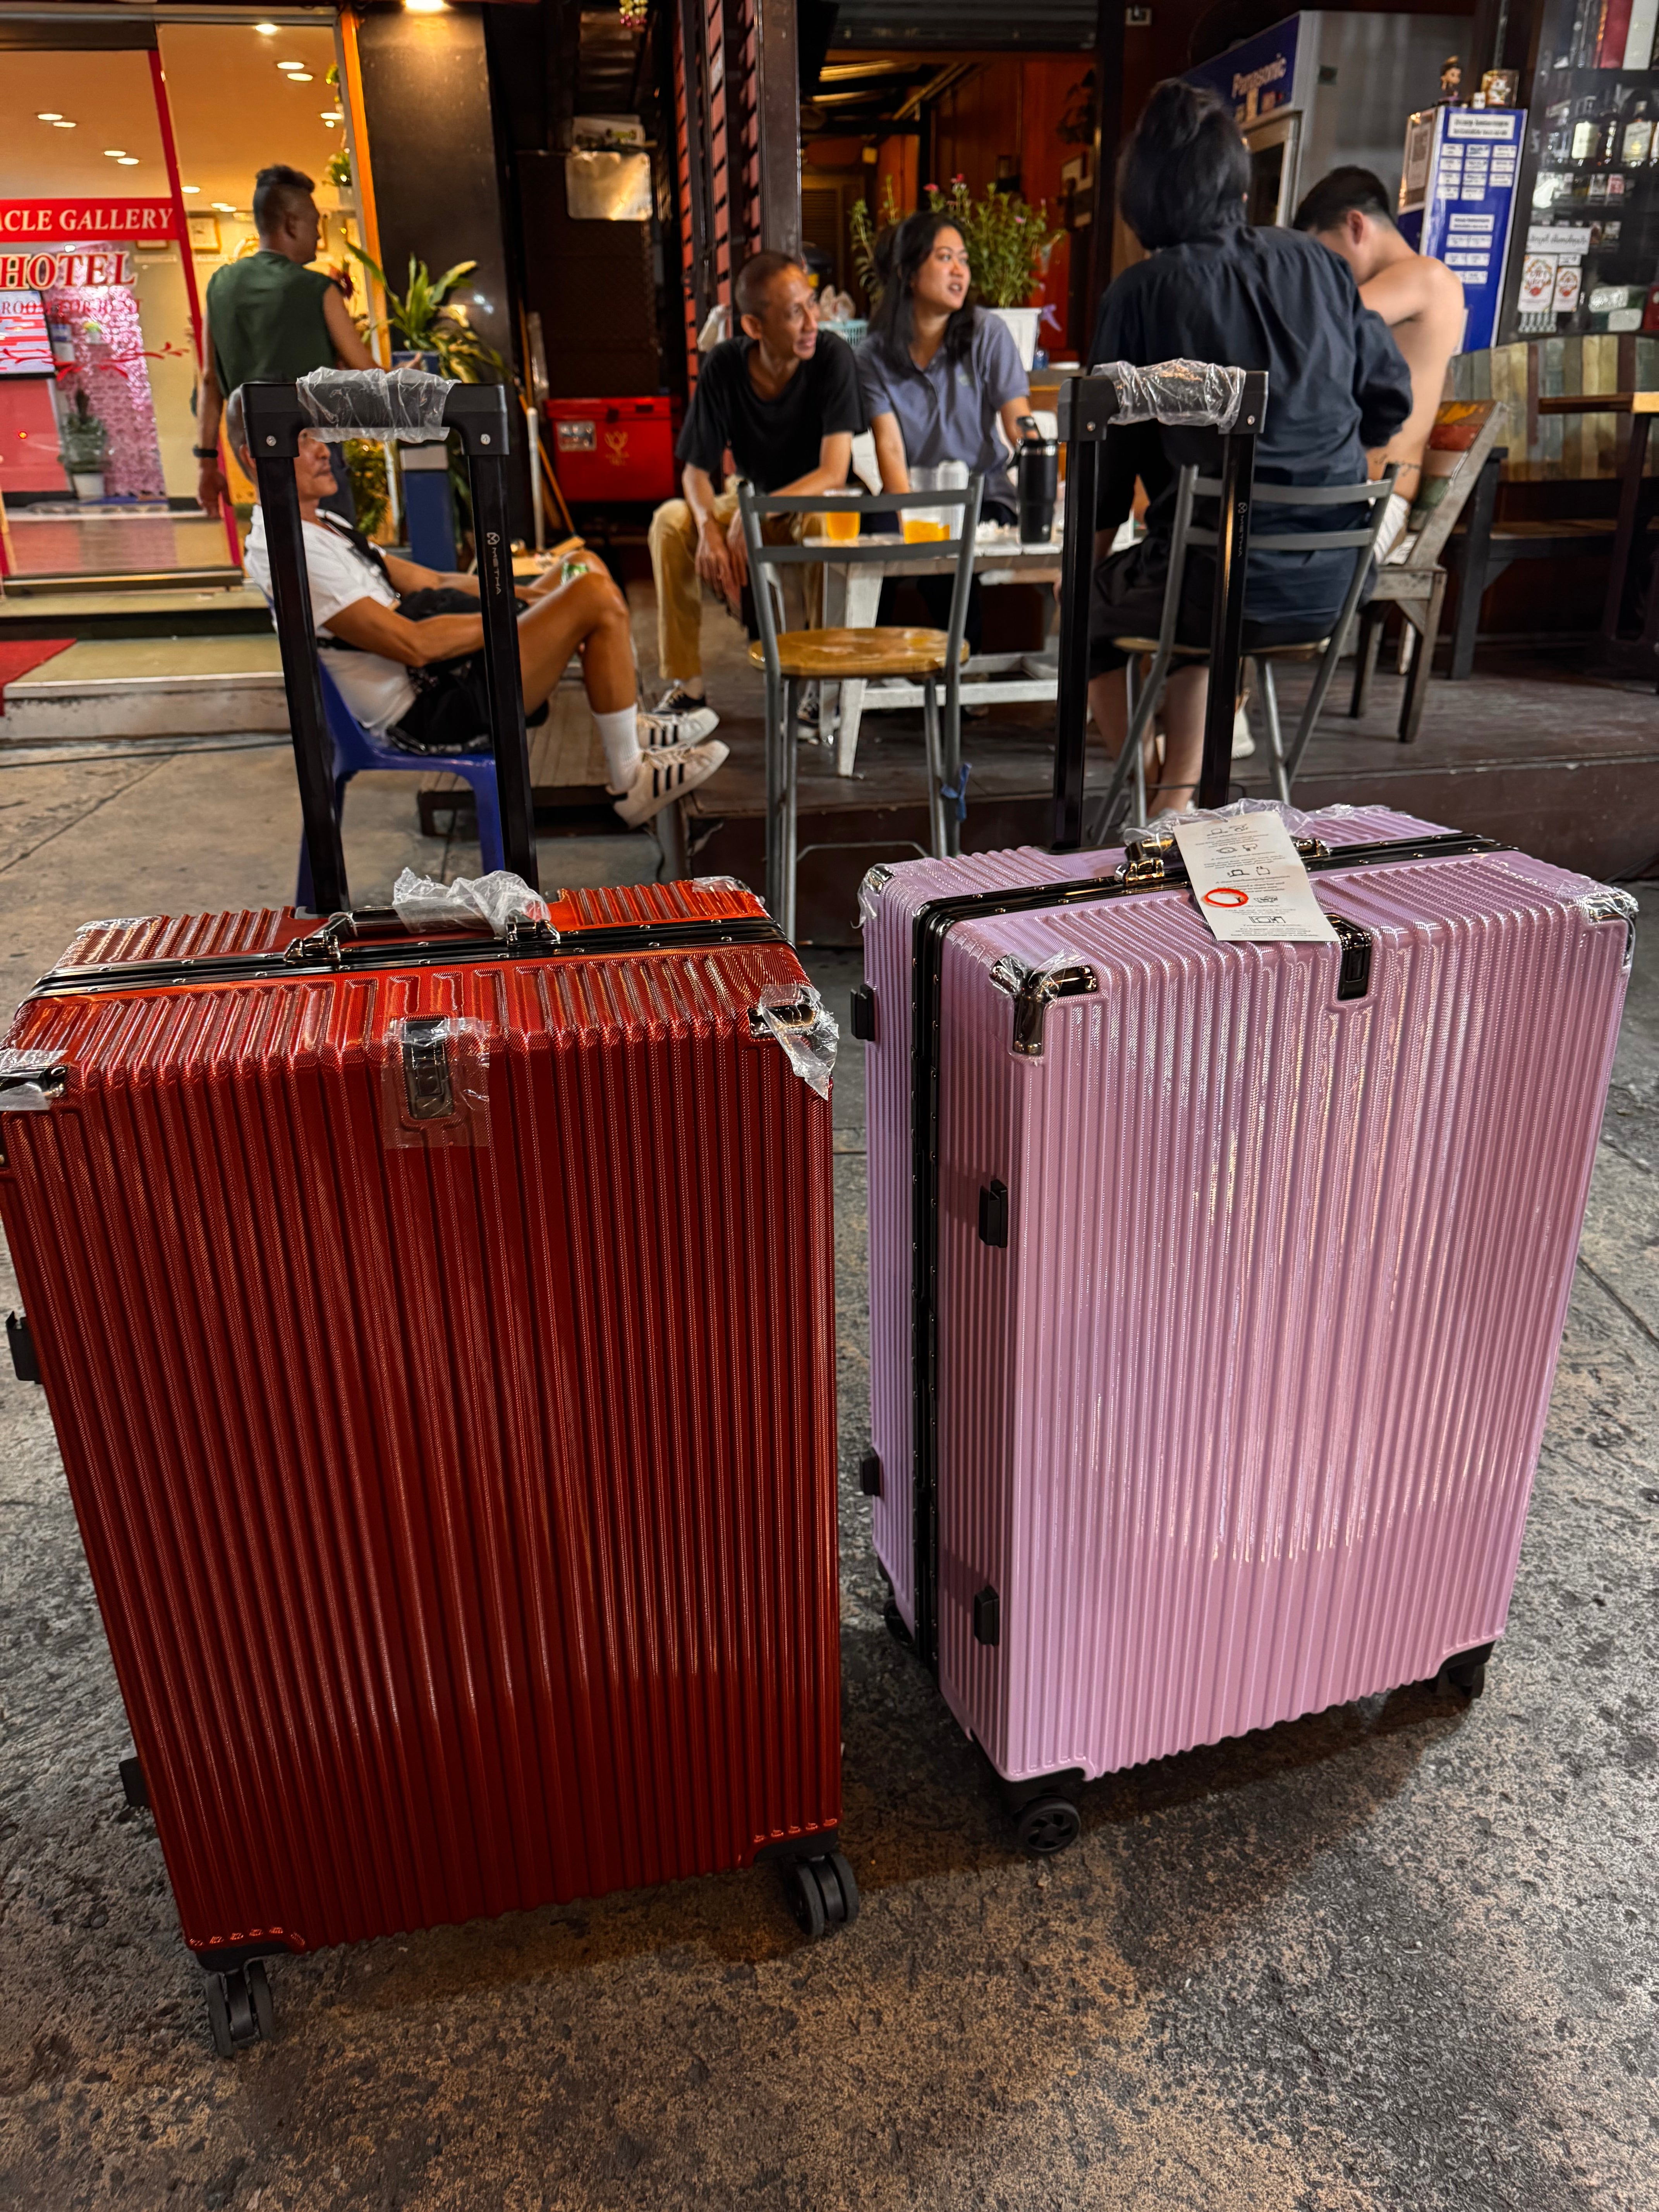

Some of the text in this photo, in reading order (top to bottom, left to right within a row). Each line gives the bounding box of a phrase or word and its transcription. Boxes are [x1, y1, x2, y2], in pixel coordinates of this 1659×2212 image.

[0, 208, 173, 231] CLE GALLERY
[0, 252, 138, 290] HOTEL
